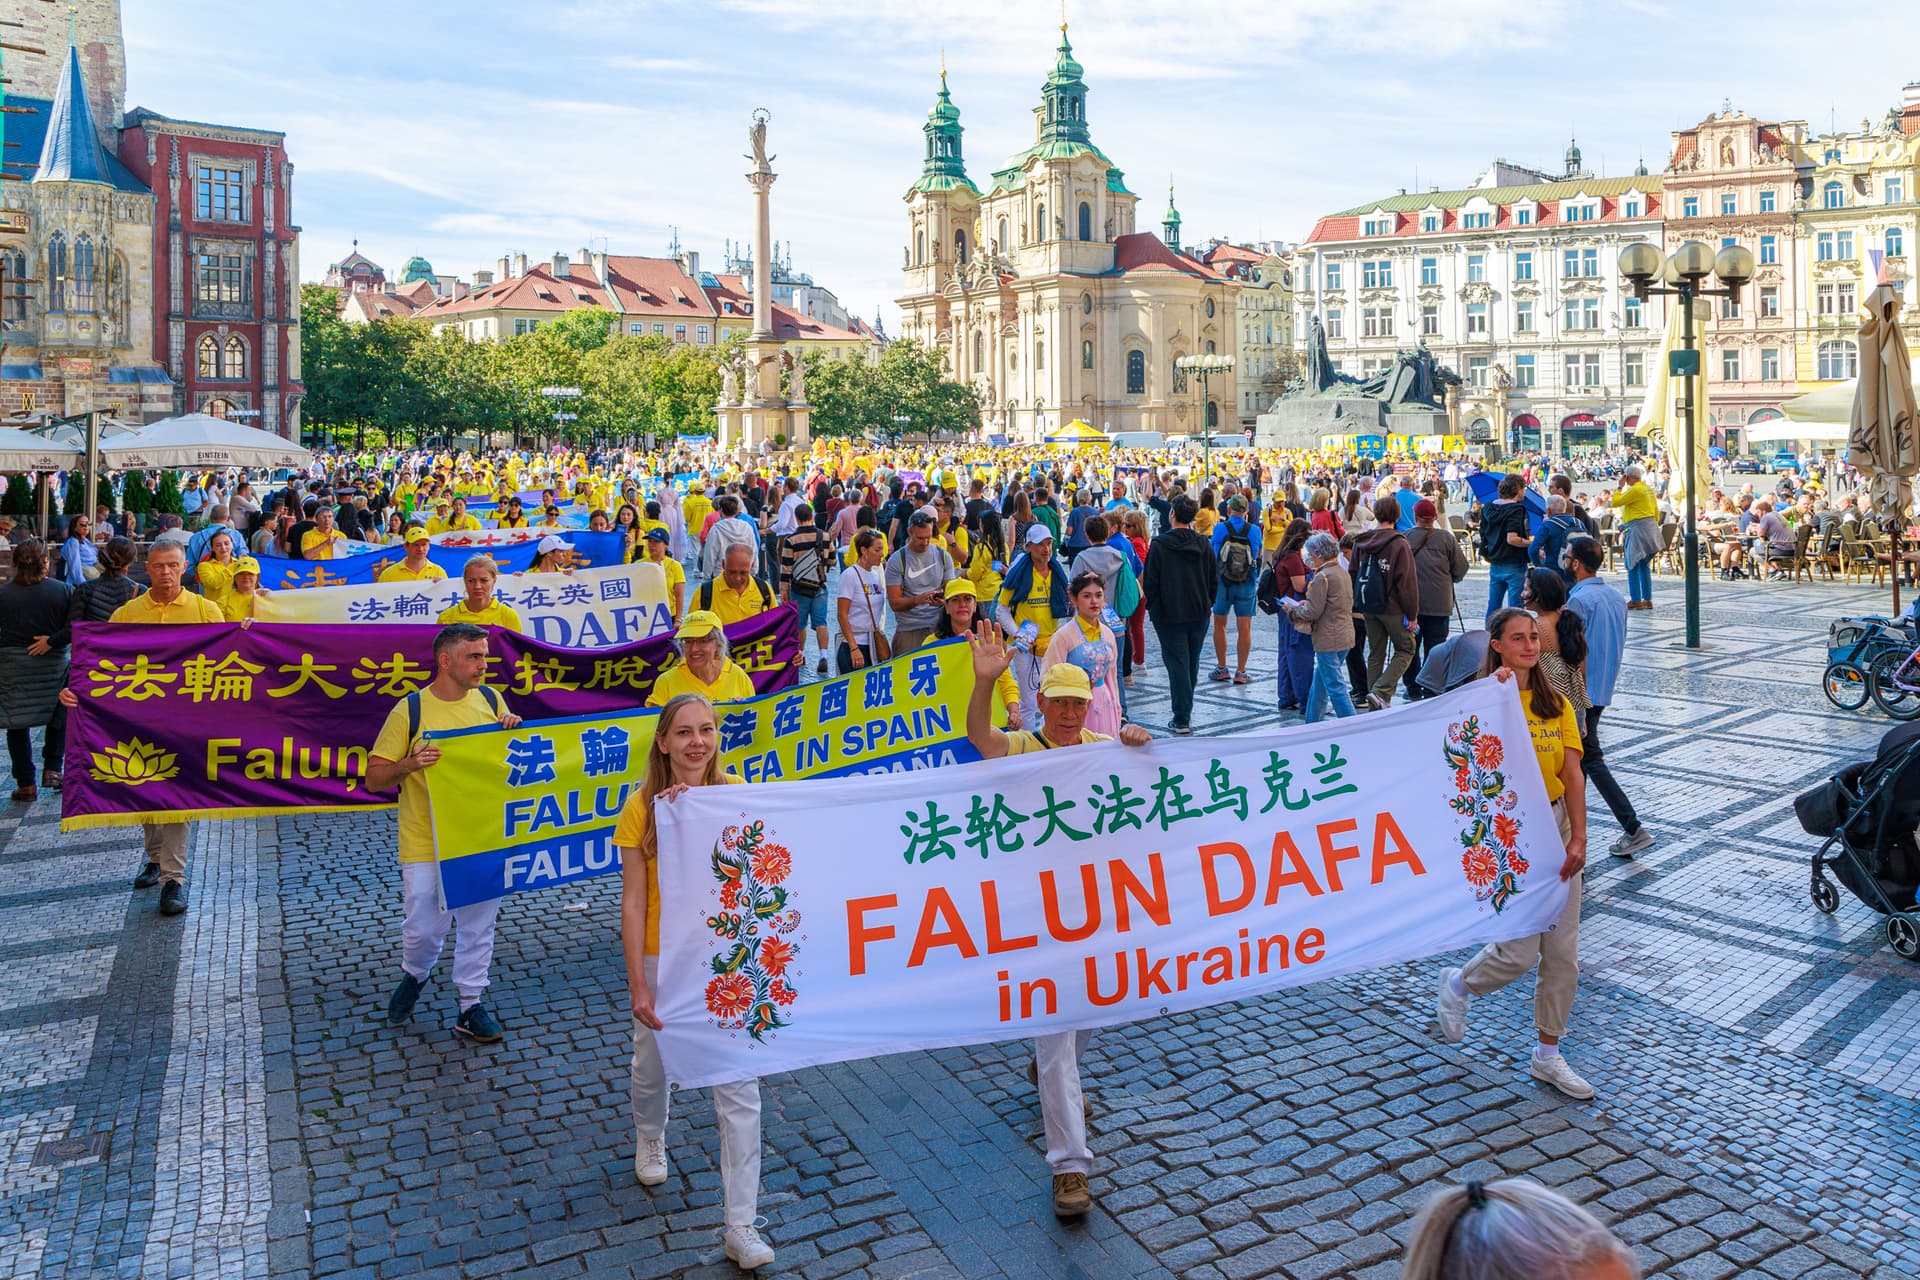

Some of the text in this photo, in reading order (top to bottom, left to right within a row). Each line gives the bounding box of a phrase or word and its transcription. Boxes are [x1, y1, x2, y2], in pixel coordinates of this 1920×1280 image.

[197, 451, 229, 459] EINSTEIN
[528, 602, 674, 648] DAFA
[504, 782, 642, 838] FALU
[795, 733, 831, 772] IN
[840, 704, 953, 757] SPAIN
[900, 743, 1359, 866] 法轮大法在乌克兰
[503, 836, 623, 889] FALU
[846, 811, 1427, 976] FALUN DAFA
[998, 927, 1327, 1022] in Ukraine
